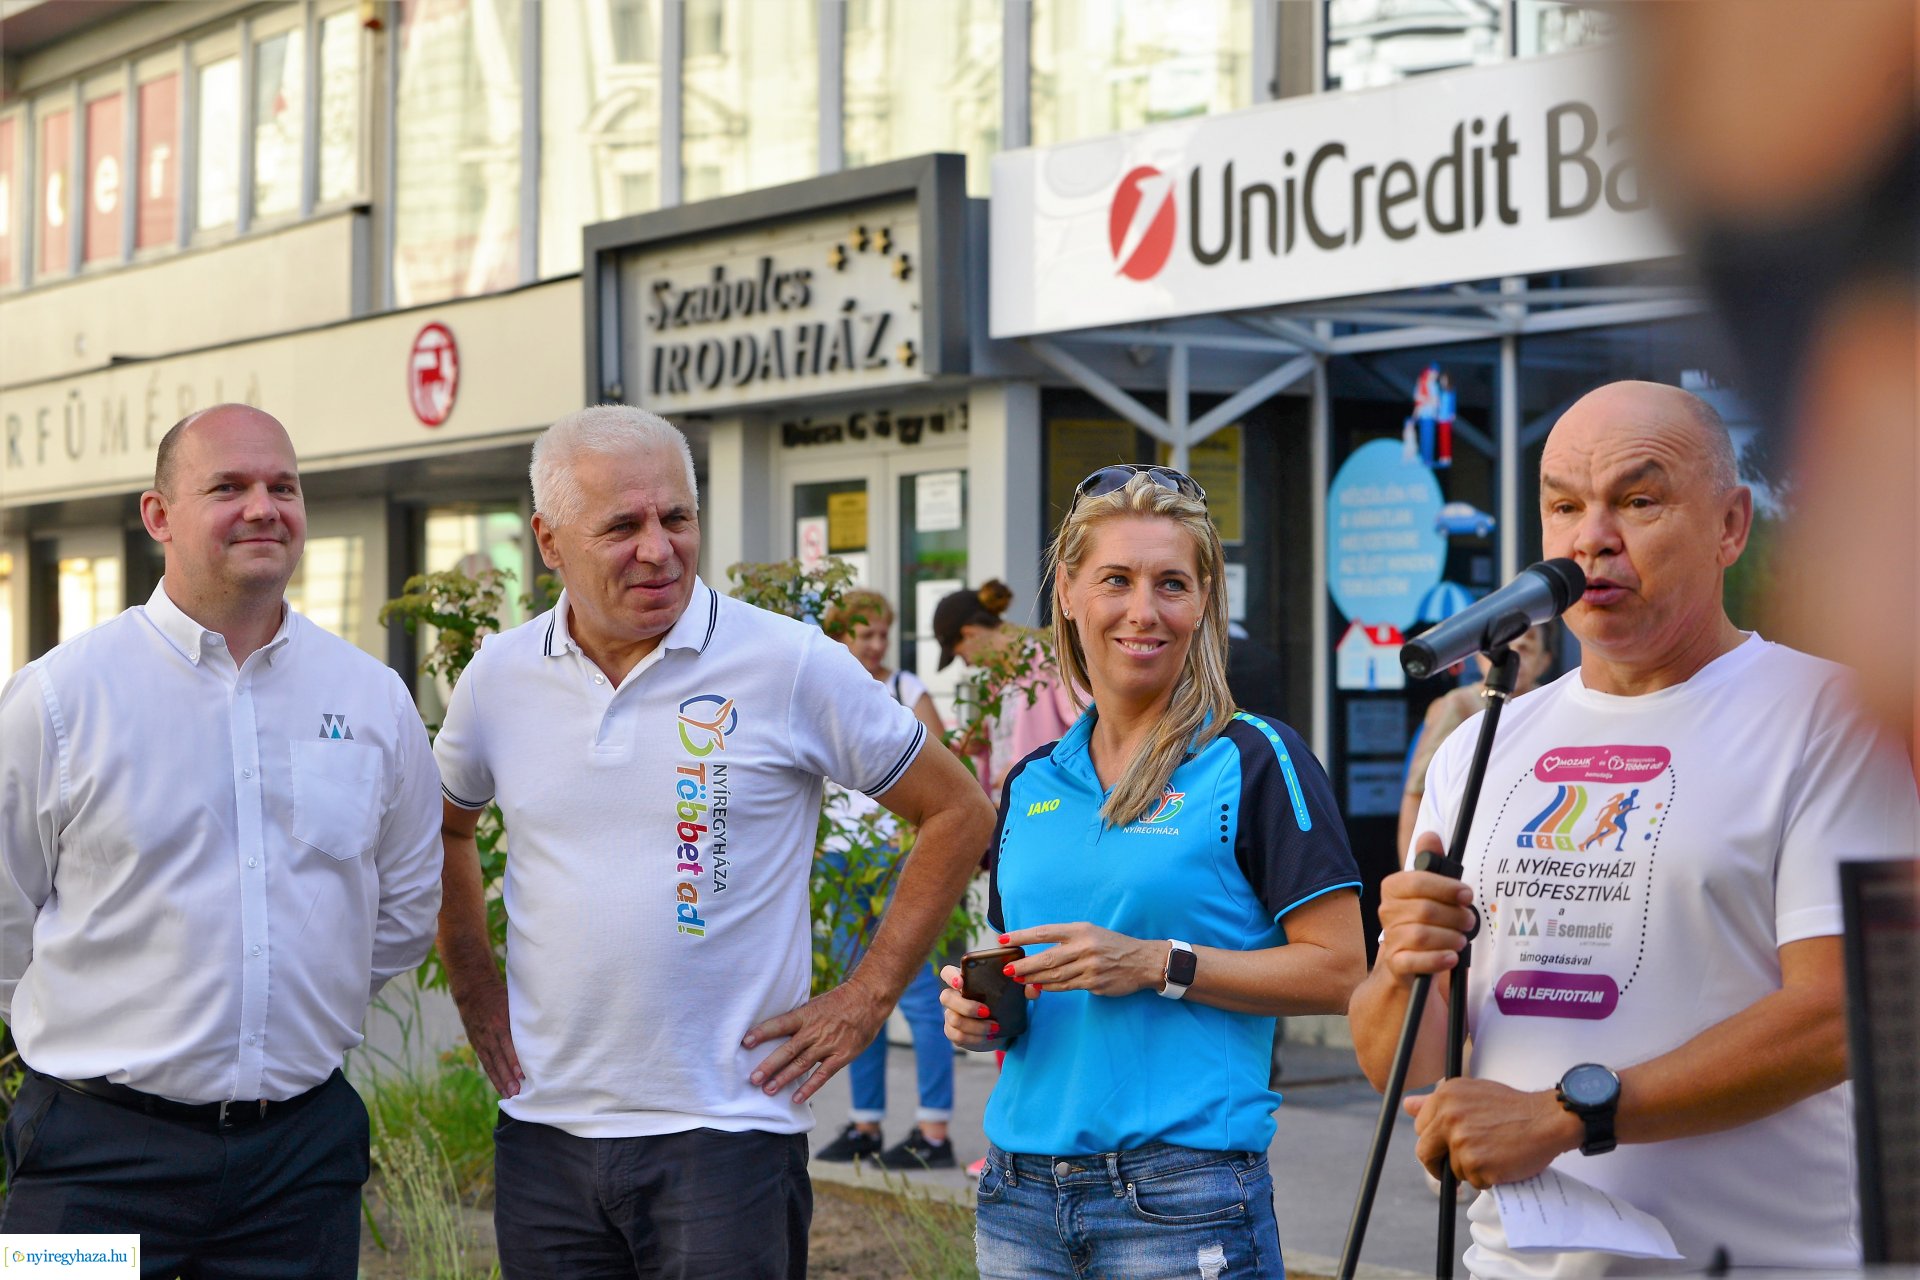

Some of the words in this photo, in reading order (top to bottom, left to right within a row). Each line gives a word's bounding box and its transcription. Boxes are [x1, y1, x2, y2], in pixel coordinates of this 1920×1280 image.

[1188, 112, 1519, 266] UniCredit
[648, 257, 813, 331] Szabolcs
[652, 299, 891, 396] IRODAHÁZ
[1558, 758, 1591, 766] MOZAIK
[1027, 798, 1061, 817] JAKO
[676, 763, 708, 876] Többet
[712, 764, 732, 893] NYÍREGYHÁZA
[1122, 826, 1180, 836] NYÍREGYHÁZA
[1522, 835, 1528, 847] 1
[1540, 835, 1549, 848] 2
[1561, 836, 1569, 849] 3
[1497, 858, 1510, 874] II.
[1515, 856, 1636, 879] NYÍREGYHÁZI
[1495, 878, 1632, 902] FUTÓFESZTIVÁL
[676, 882, 706, 937] ad!
[1558, 907, 1566, 916] a
[1558, 922, 1613, 939] sematic
[1519, 951, 1593, 966] támogatásával
[1503, 983, 1518, 999] ÉN
[1517, 986, 1528, 999] IS
[1528, 986, 1605, 1003] LEFUTOTTAM
